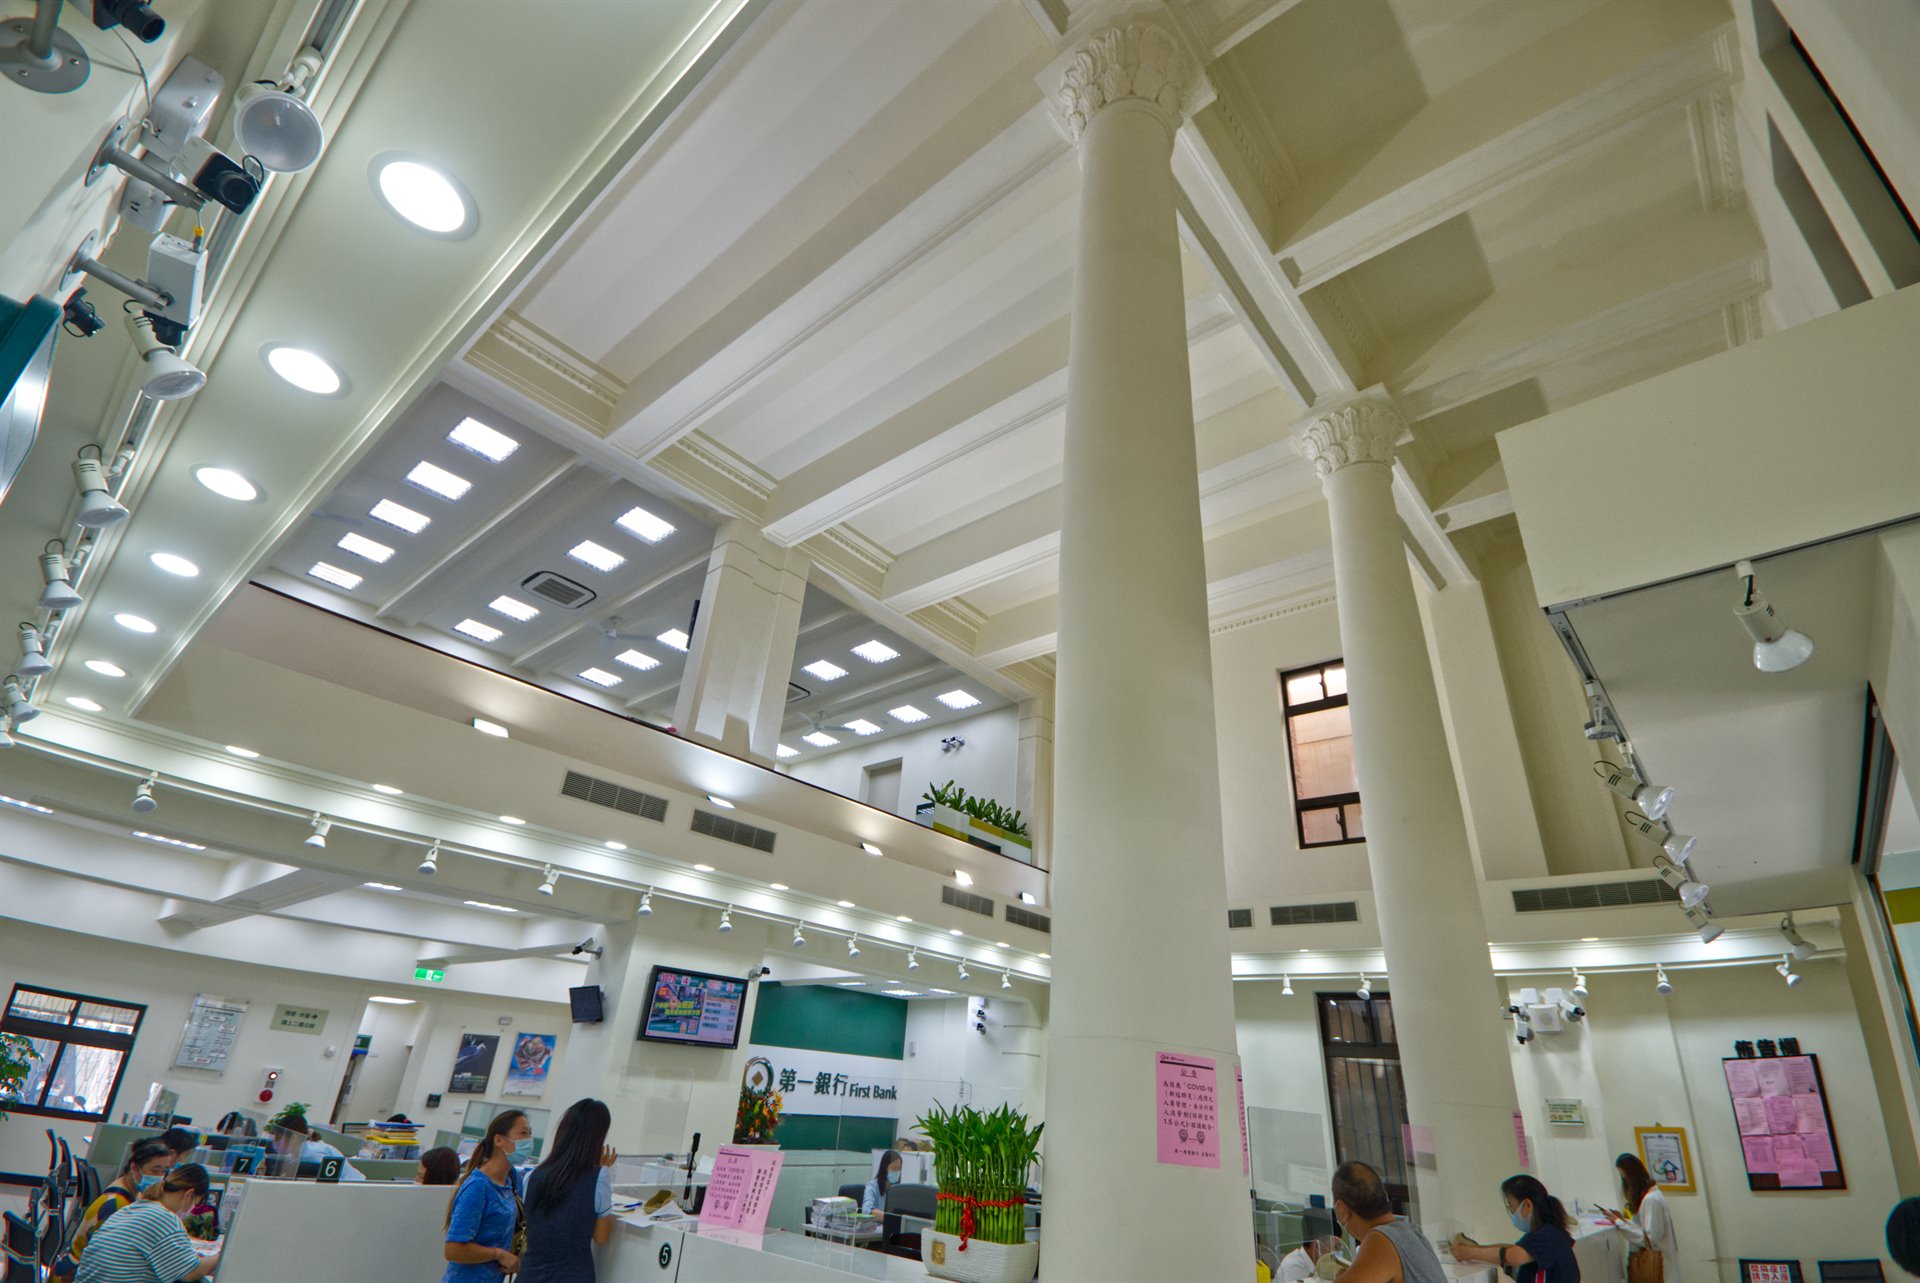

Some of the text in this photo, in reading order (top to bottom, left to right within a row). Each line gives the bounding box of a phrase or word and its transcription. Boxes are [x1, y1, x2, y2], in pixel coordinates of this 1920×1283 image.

[778, 1068, 898, 1100] 第一銀行 First Bank
[239, 1158, 249, 1172] 7
[325, 1160, 338, 1177] 6
[661, 1246, 670, 1265] 5
